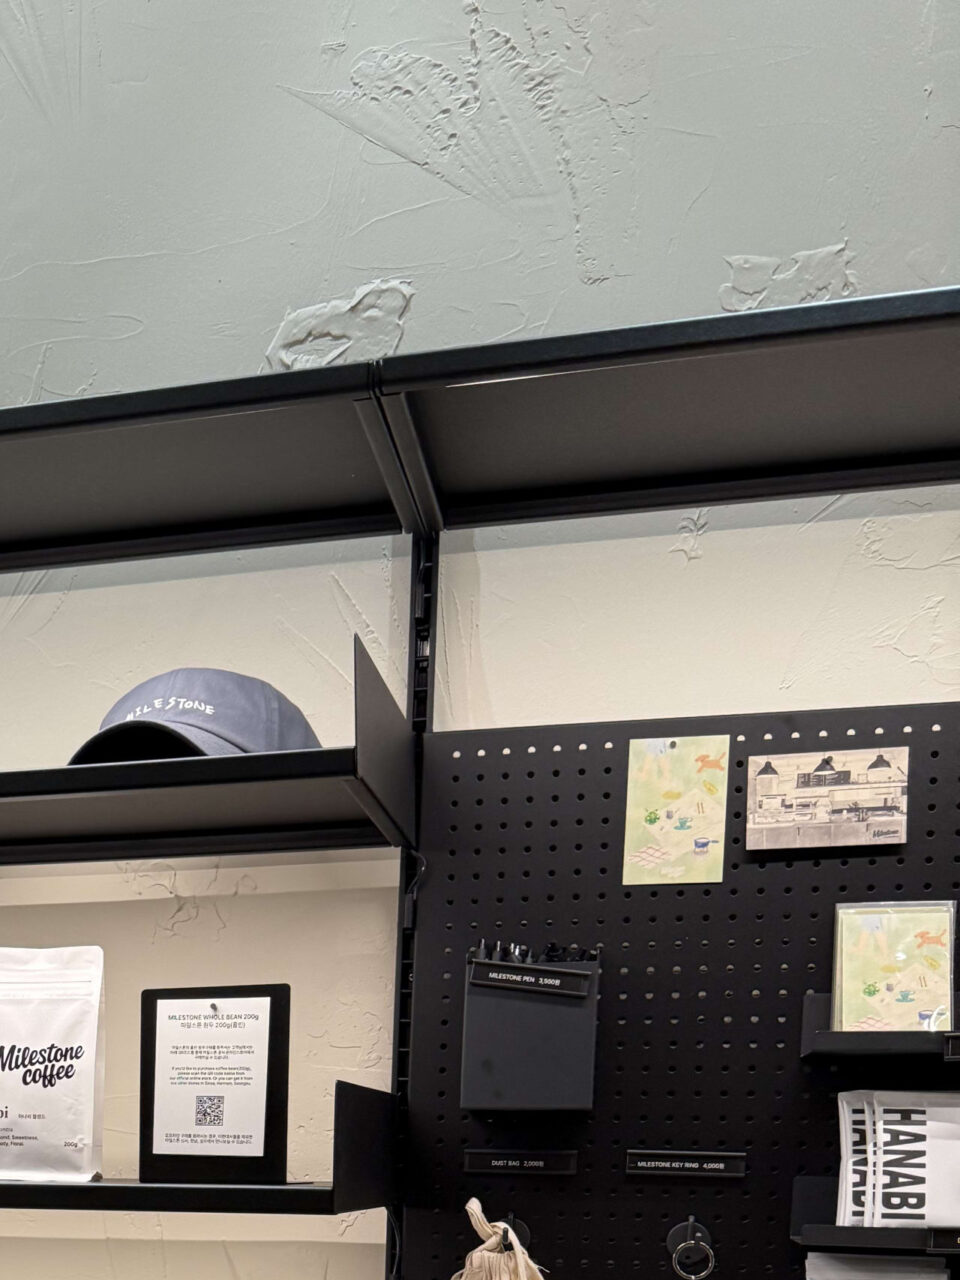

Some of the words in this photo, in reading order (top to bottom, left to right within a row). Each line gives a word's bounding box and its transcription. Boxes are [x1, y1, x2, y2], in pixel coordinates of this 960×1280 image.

[125, 696, 216, 721] MILESTONE
[488, 971, 522, 982] MILESTONE
[243, 1013, 260, 1021] 200g
[21, 1063, 77, 1091] coffee
[881, 1107, 927, 1221] HANABI
